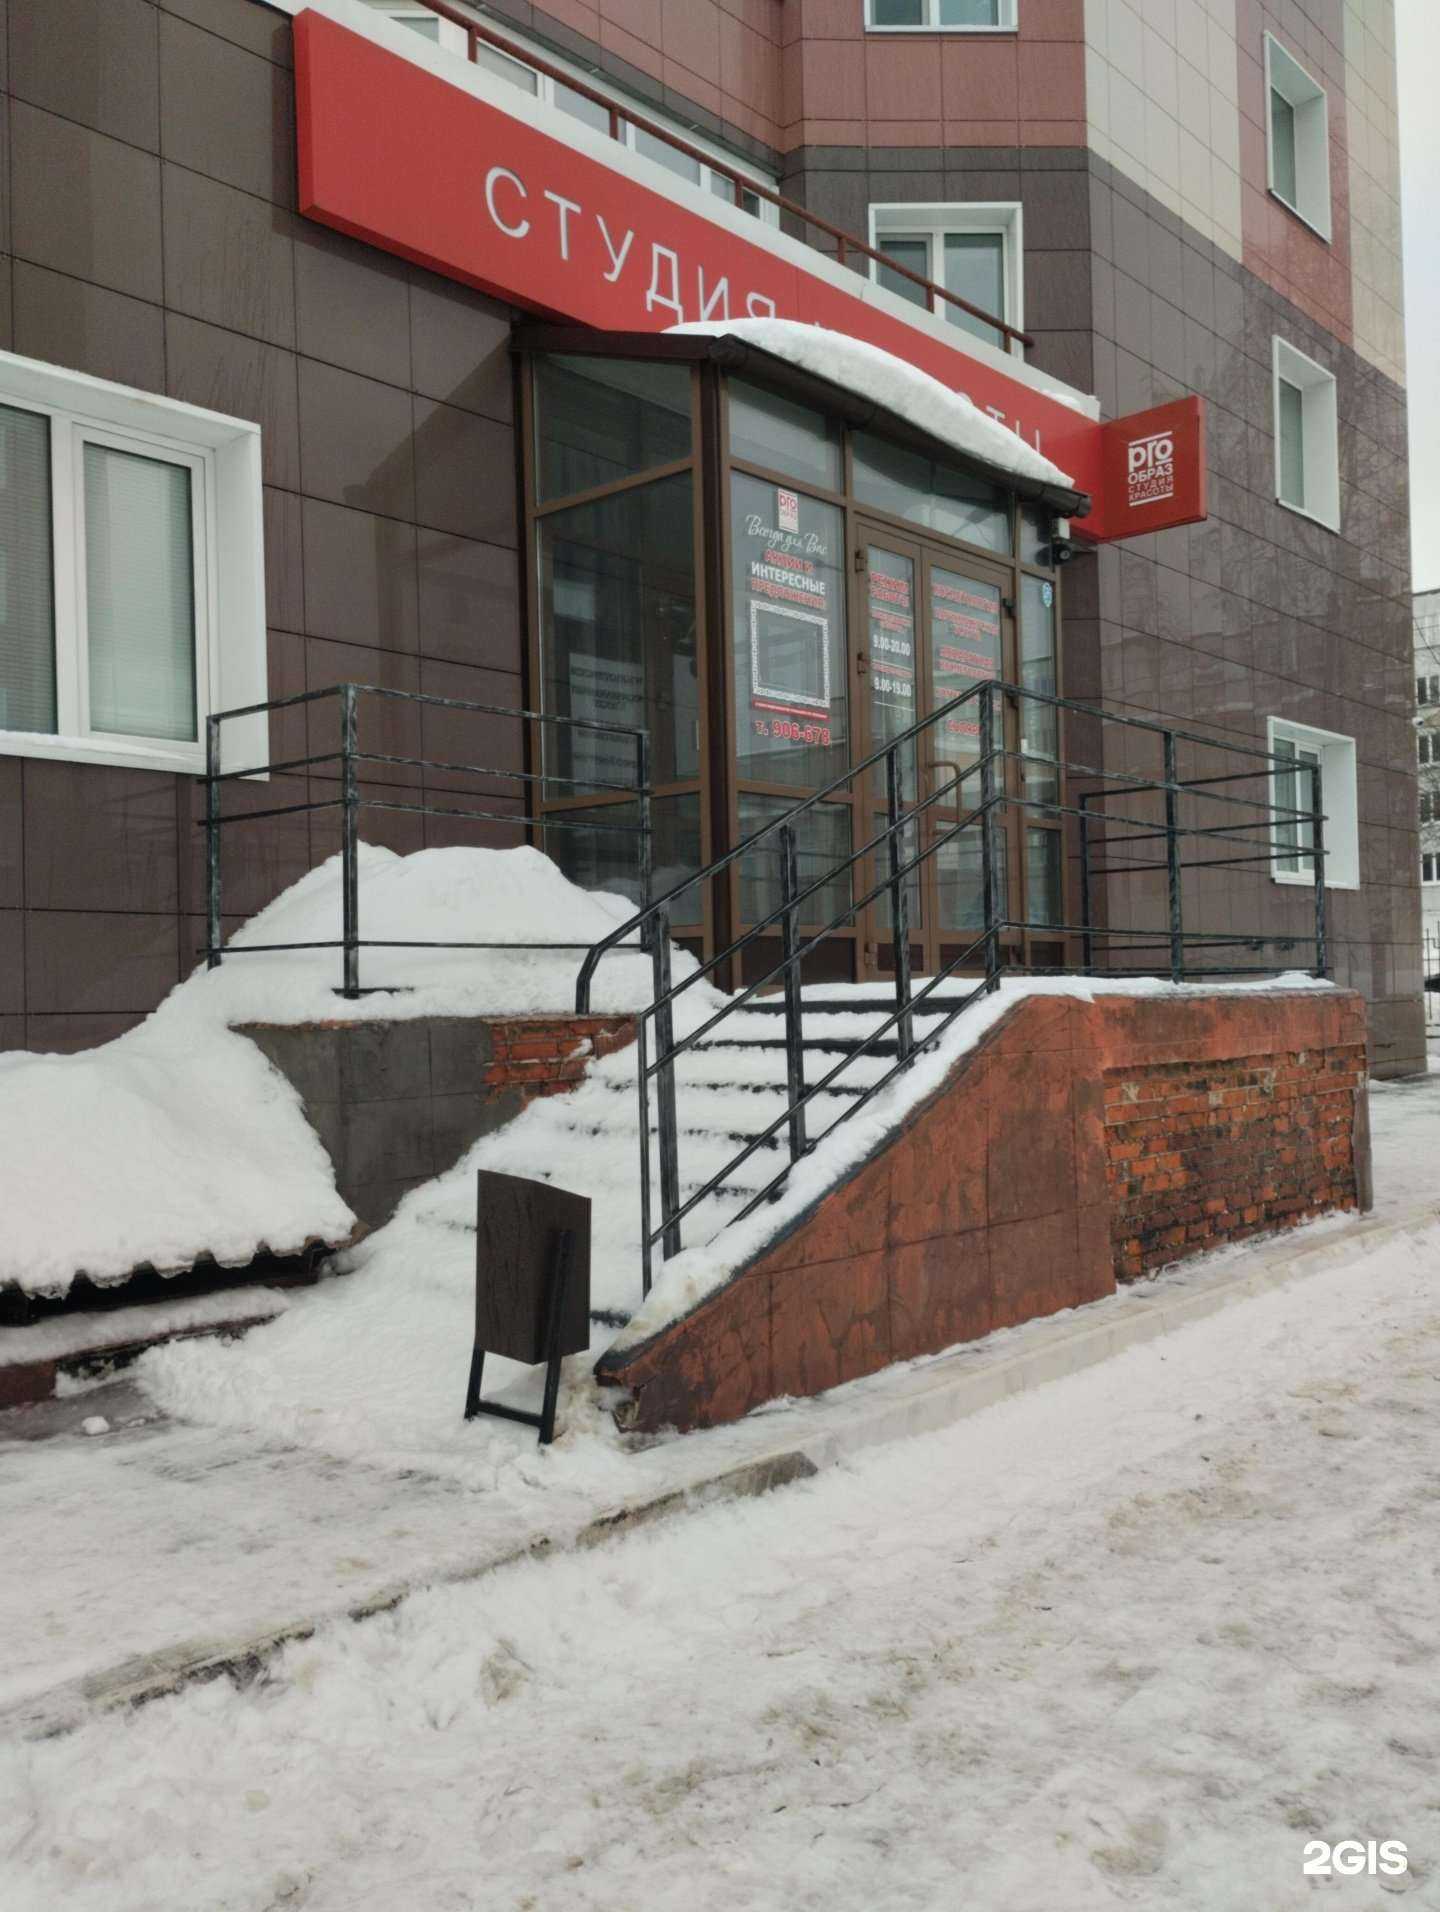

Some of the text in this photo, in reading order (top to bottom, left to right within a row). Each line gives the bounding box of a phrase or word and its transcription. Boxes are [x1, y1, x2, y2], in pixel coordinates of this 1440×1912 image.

[1128, 438, 1174, 474] pro
[1128, 463, 1174, 485] ОБРАЗ
[1128, 475, 1174, 494] СТУДИЯ
[1128, 483, 1174, 501] КРАСОТЫ
[745, 514, 784, 548] Всегда
[804, 532, 828, 555] Вас
[751, 560, 827, 596] ИНТЕРЕСНЫЕ
